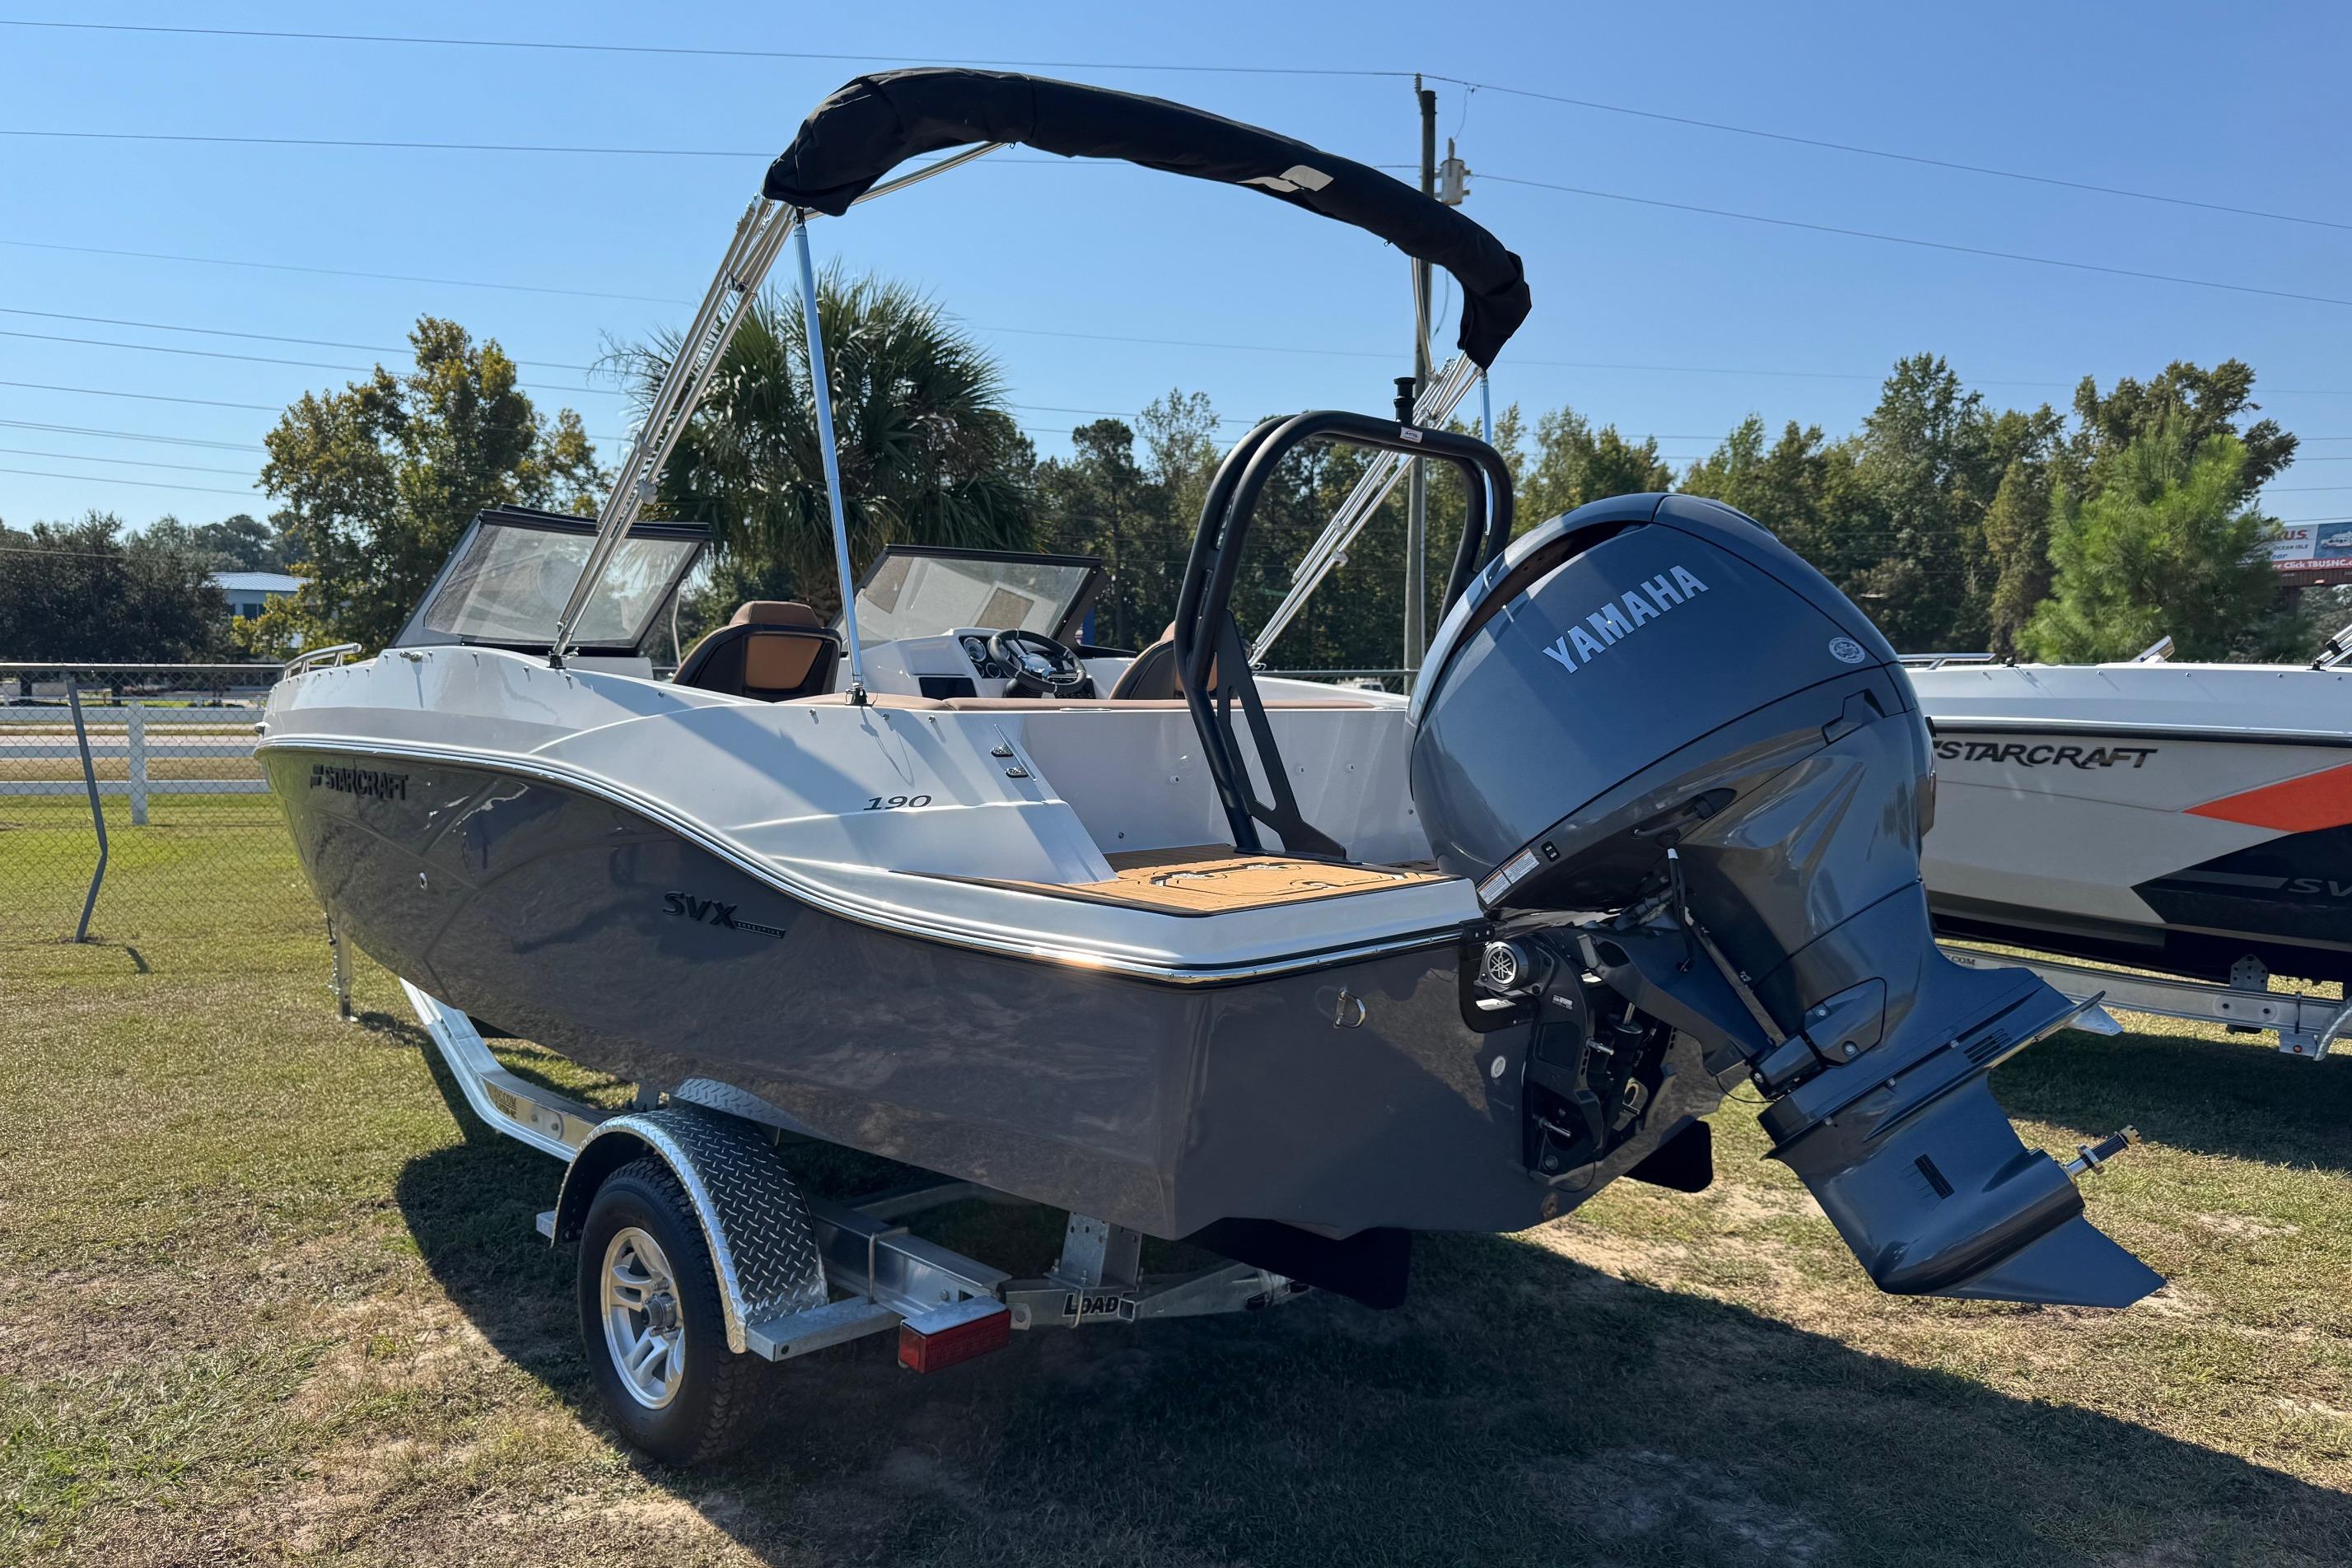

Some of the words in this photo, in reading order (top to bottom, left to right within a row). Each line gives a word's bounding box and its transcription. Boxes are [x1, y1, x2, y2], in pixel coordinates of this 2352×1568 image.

[2283, 561, 2306, 569] Click
[1542, 565, 1710, 674] YAMAHA
[1937, 741, 2158, 769] STARCRAFT
[325, 766, 408, 800] STARCRAFT
[863, 795, 932, 810] 190
[662, 891, 738, 929] SVX
